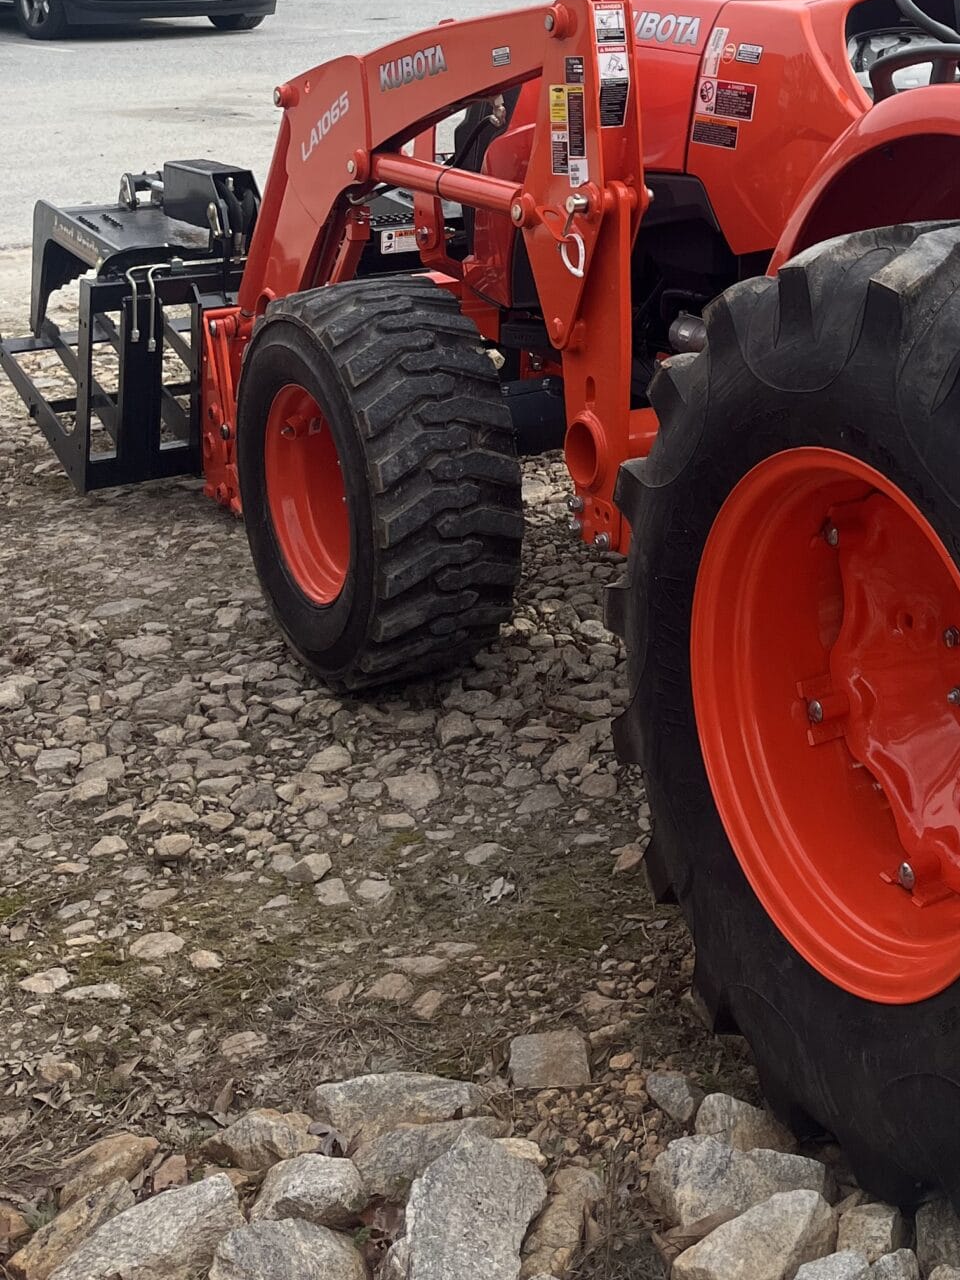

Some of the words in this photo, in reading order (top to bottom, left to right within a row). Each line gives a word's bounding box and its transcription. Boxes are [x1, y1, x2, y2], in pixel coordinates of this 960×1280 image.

[632, 10, 700, 45] UBOTA
[379, 44, 448, 92] KUBOTA
[301, 90, 349, 161] LA1065
